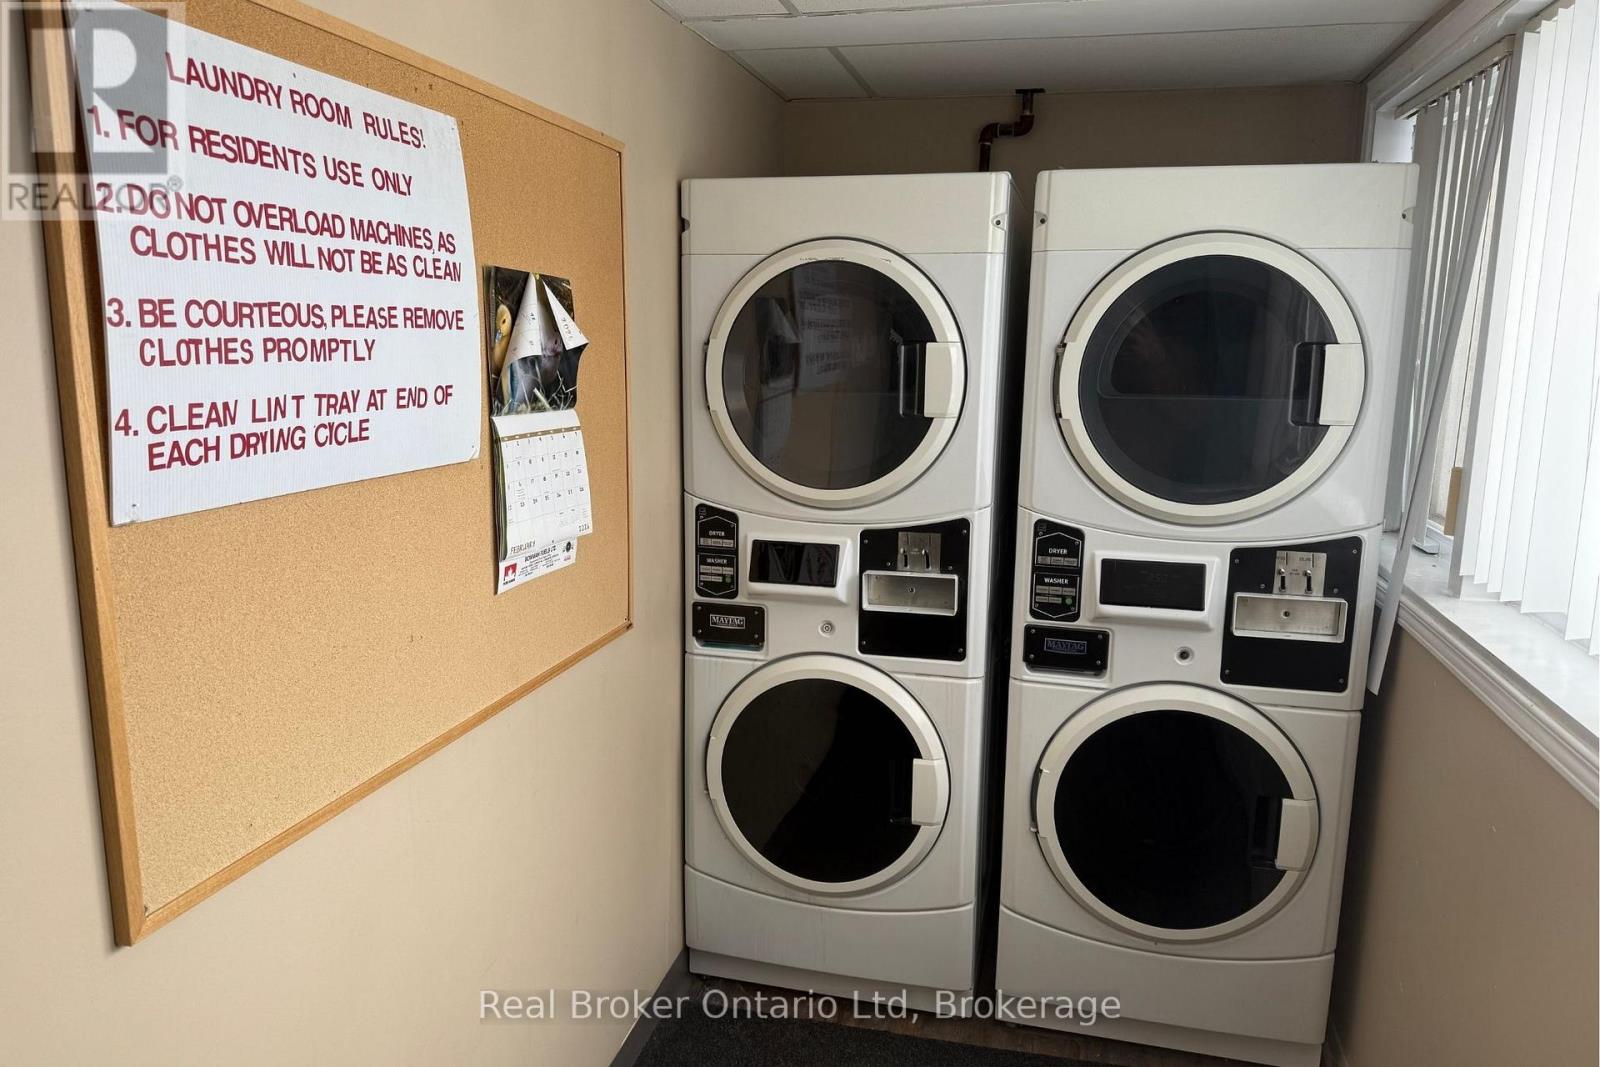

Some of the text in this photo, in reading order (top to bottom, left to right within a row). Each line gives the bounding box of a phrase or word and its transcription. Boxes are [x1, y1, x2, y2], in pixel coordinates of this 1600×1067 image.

[165, 53, 426, 149] LAUNDRY ROOM RULES!
[87, 105, 413, 196] 1. FOR RESIDENTS USE ONLY
[96, 183, 456, 254] 2. DO NOT OVERLOAD MACHINES, AS
[130, 225, 461, 282] CLOTHES WILL NOT BE AS CLEAN
[107, 298, 464, 330] 3. BE COURTEOUS, PLEASE REMOVE
[139, 337, 375, 366] CLOTHES PROMPTLY
[115, 409, 139, 436] 4.
[147, 400, 237, 435] CLEAN
[314, 389, 360, 417] TRAY
[367, 389, 387, 411] AT
[396, 386, 428, 409] END
[434, 385, 453, 405] OF
[148, 419, 369, 471] EACH DRYING CYCLE
[1048, 547, 1068, 555] DRYER
[1044, 577, 1069, 585] WASHER
[711, 614, 744, 625] MAYTAG
[1046, 639, 1085, 650] MAYTAG
